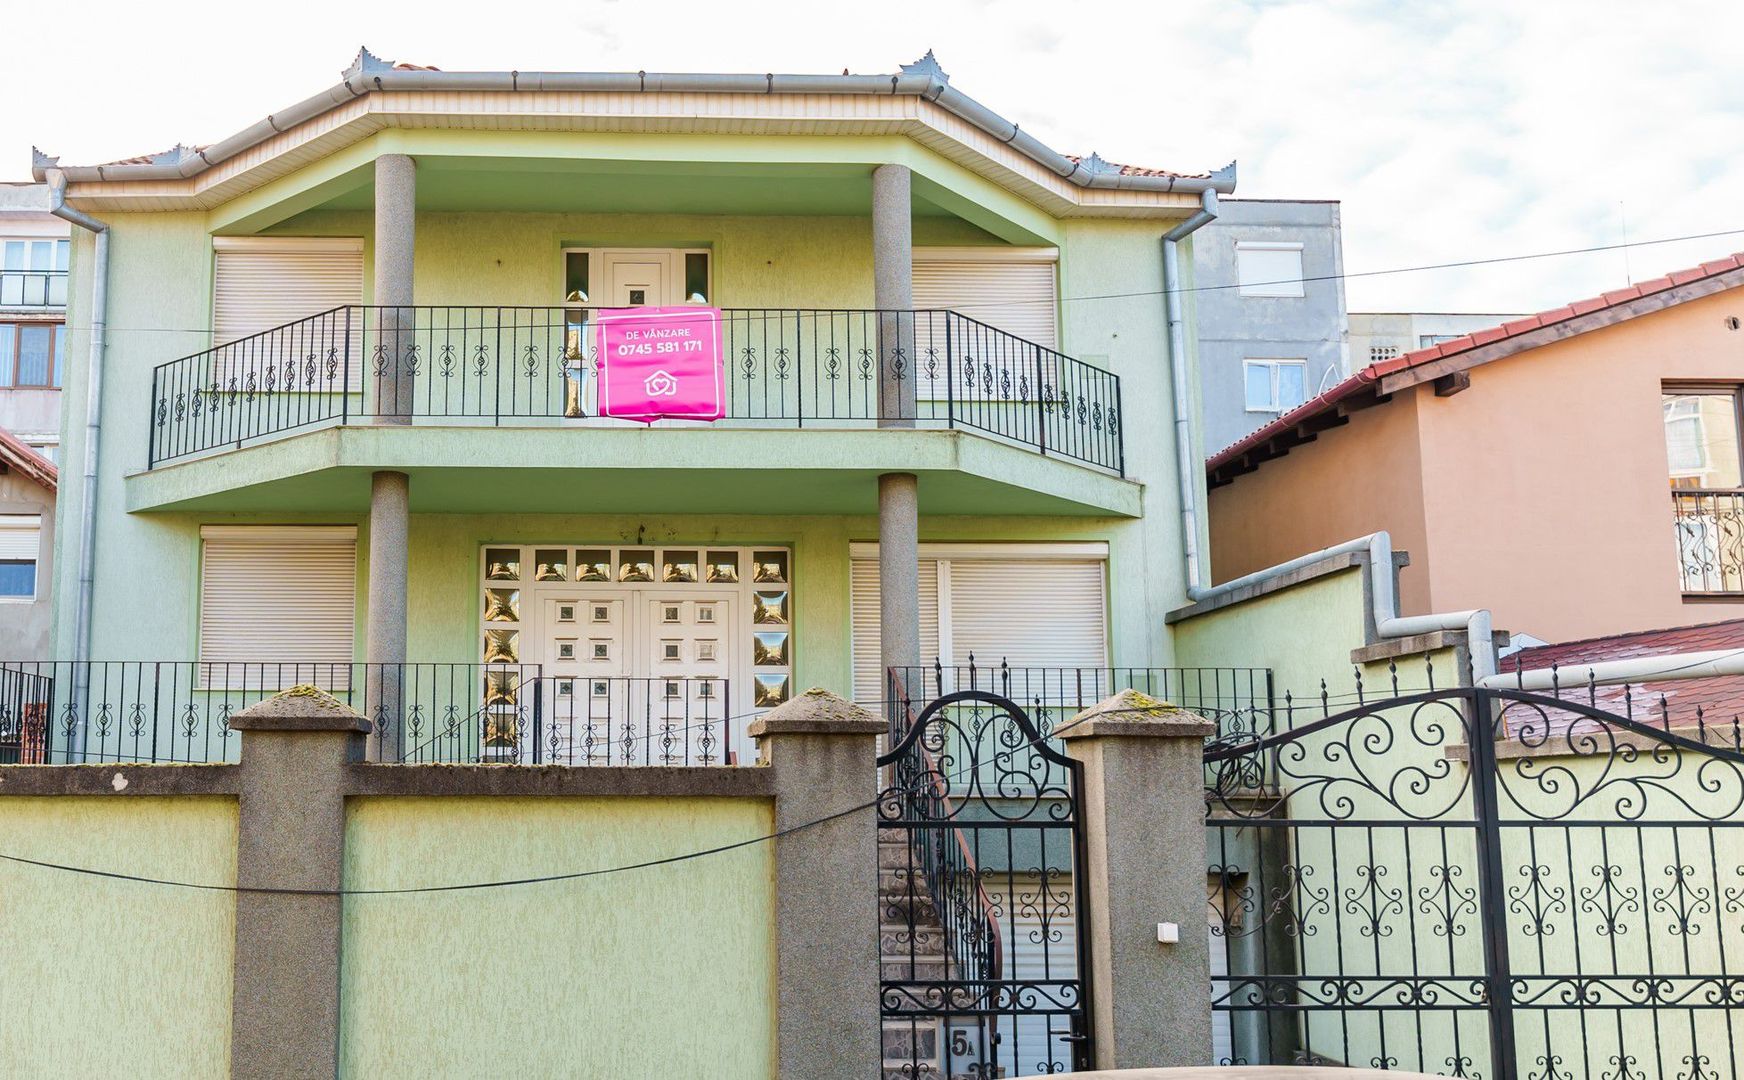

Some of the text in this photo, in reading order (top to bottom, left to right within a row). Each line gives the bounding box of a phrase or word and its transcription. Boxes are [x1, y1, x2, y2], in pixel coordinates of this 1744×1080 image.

[626, 328, 691, 340] DE VÂNZARE
[618, 340, 702, 356] 0745 581 171
